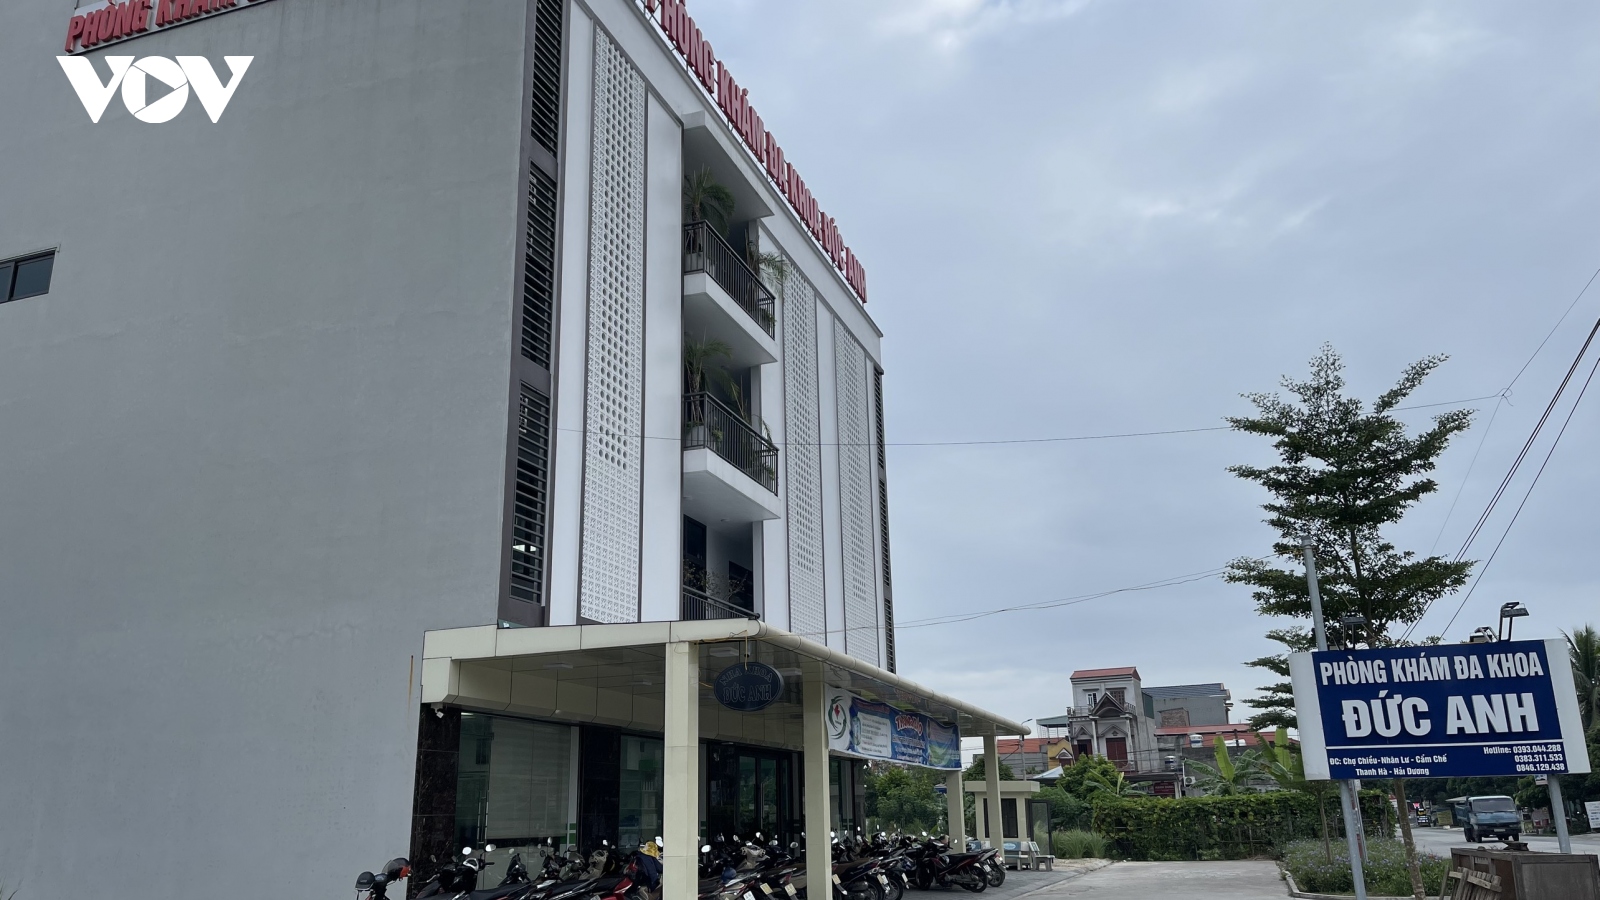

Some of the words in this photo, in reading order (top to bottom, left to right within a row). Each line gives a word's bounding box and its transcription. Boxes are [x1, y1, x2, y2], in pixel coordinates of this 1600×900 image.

[65, 0, 152, 53] PHÒNG
[717, 60, 765, 164] KHÁM
[764, 131, 787, 195] ĐA
[786, 162, 821, 241] KHOA
[820, 212, 845, 271] ĐỨC
[845, 246, 867, 303] ANH
[1319, 656, 1387, 686] PHÒNG
[1391, 652, 1451, 682] KHÁM
[1454, 655, 1484, 680] ĐA
[1487, 652, 1544, 678] KHOA
[748, 684, 772, 701] ANH
[1342, 690, 1431, 738] ĐỨC
[1446, 693, 1539, 735] ANH
[1483, 746, 1512, 754] Hotline:
[1355, 768, 1377, 776] Thanh
[1406, 768, 1430, 776] Dương
